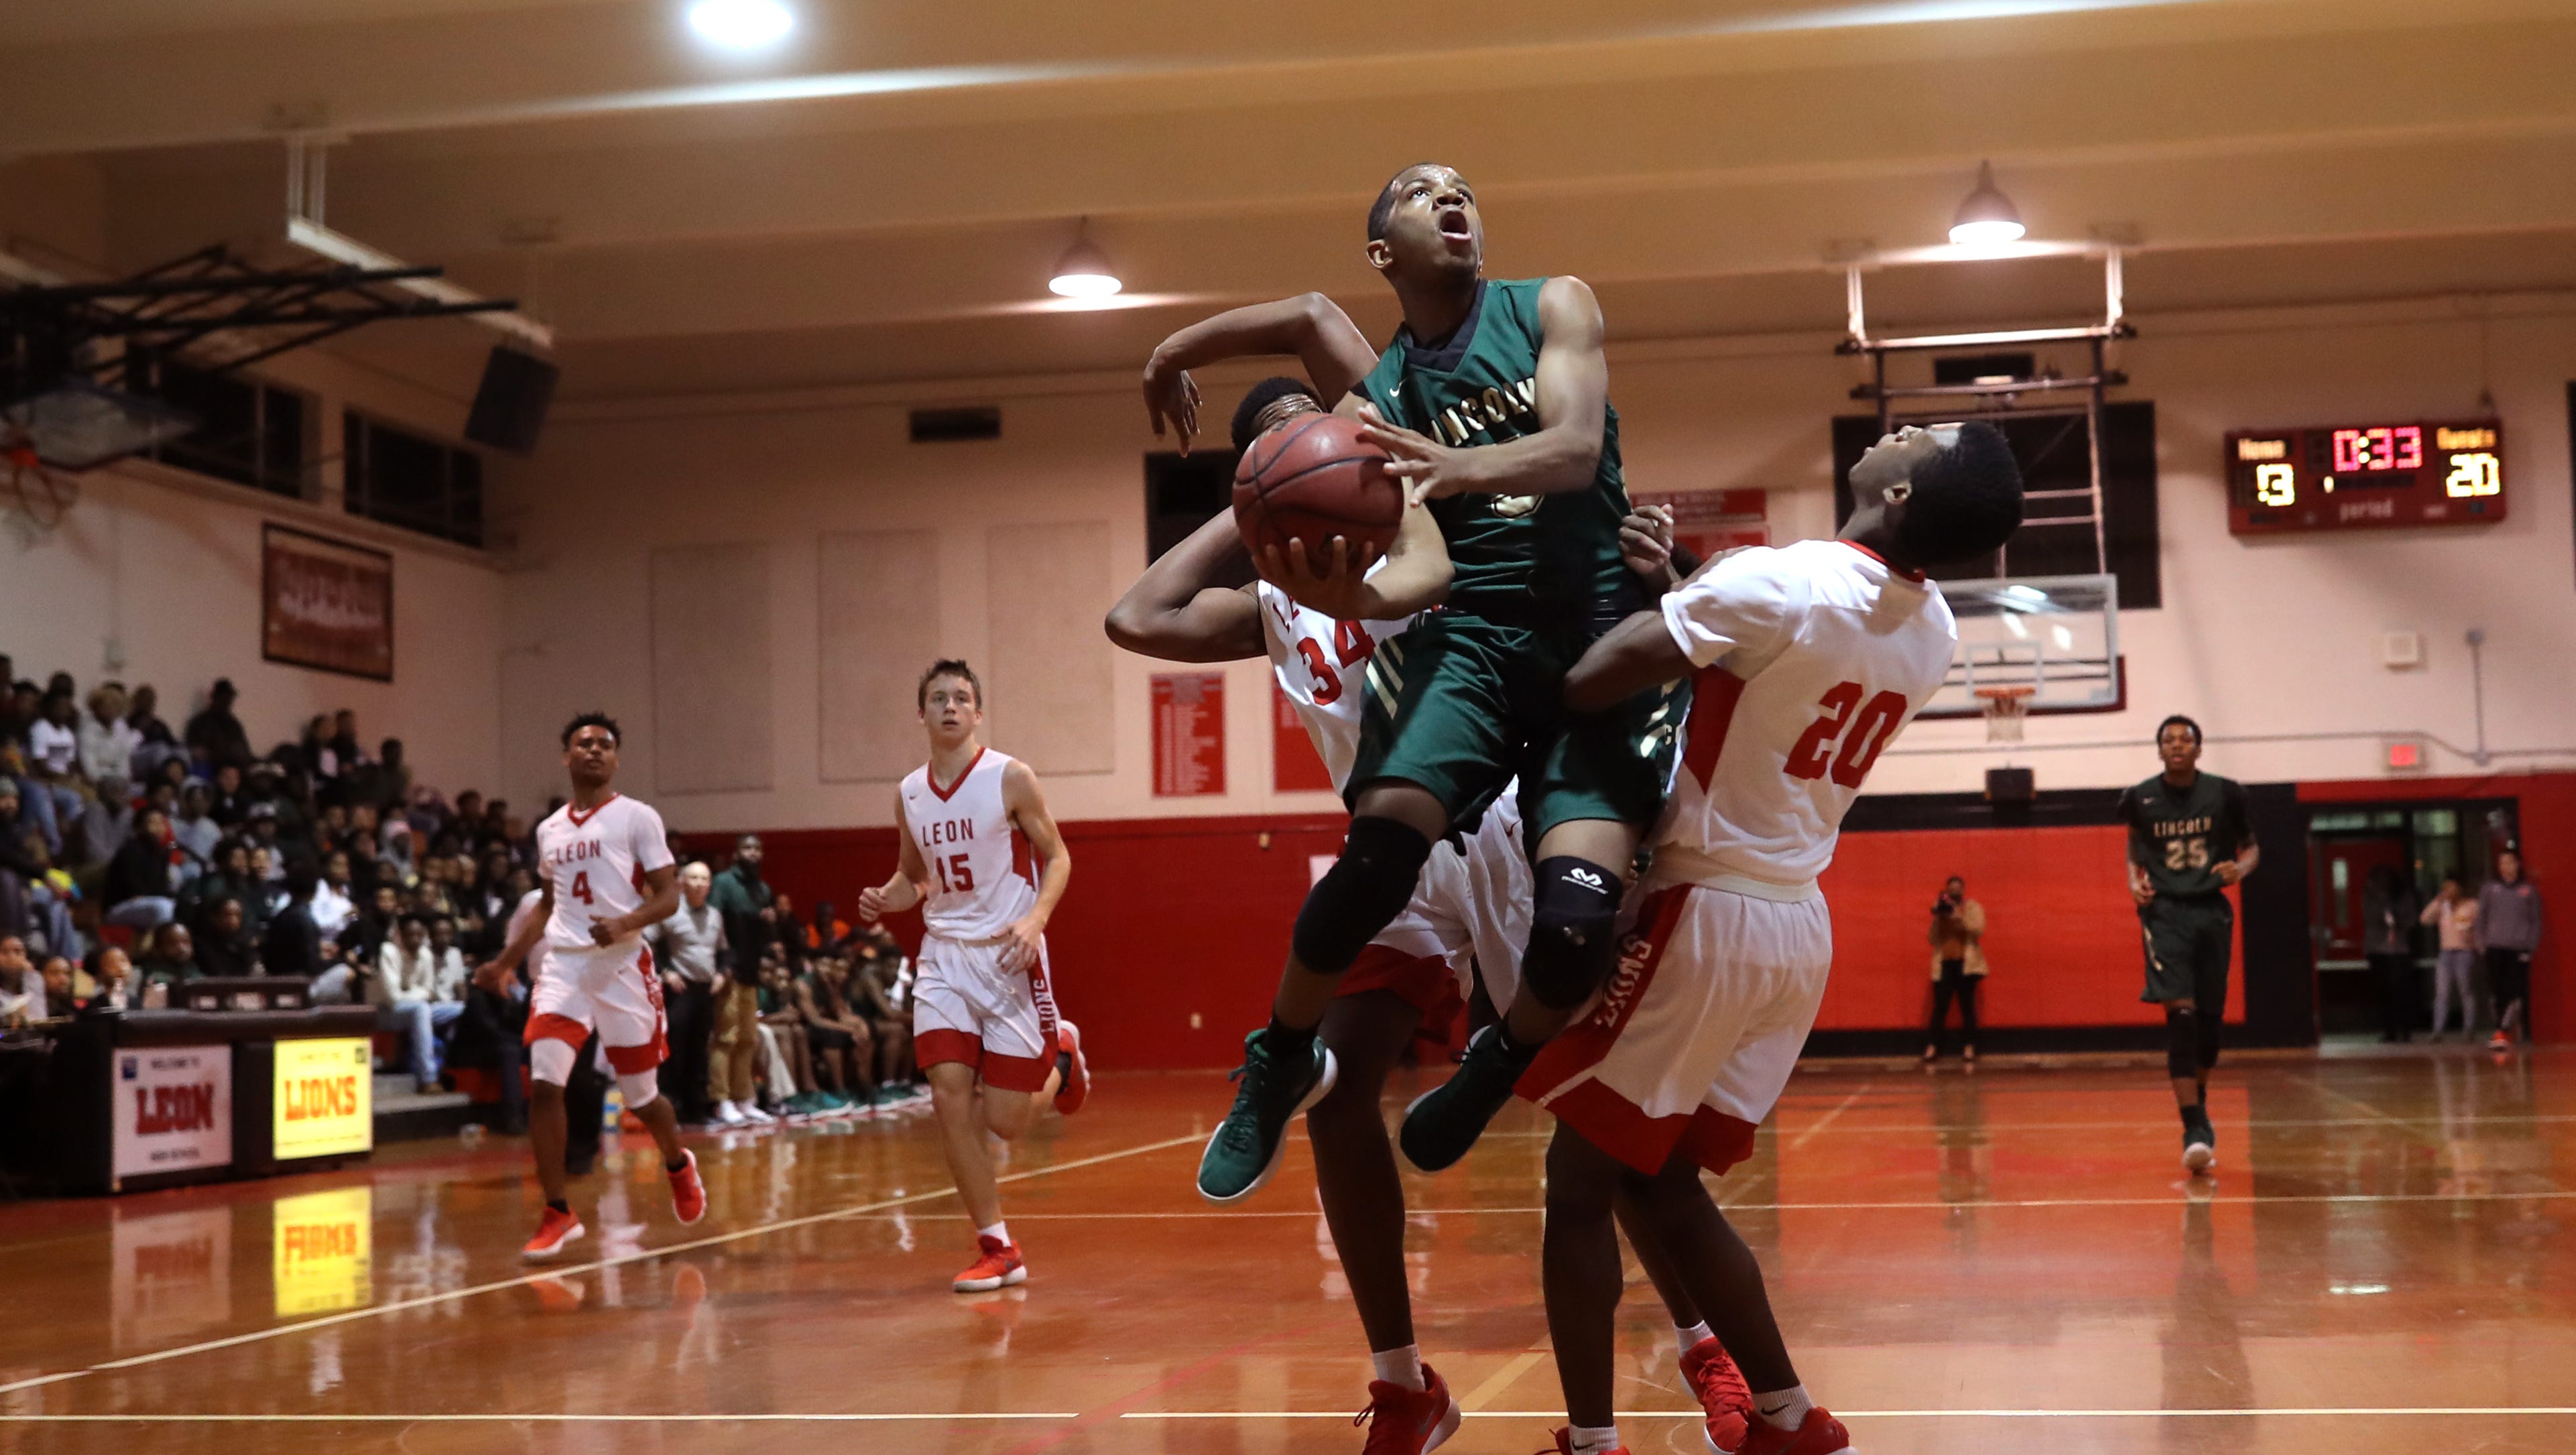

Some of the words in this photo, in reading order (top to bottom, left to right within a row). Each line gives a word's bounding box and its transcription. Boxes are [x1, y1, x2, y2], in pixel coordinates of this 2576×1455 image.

[1430, 377, 1536, 446] INCOLN
[2334, 427, 2422, 471] 0:33
[2446, 453, 2500, 497] 20
[1297, 621, 1375, 706] 34
[1783, 681, 1908, 789] 20
[922, 818, 973, 847] LEON
[2154, 816, 2211, 837] LINCOLN
[556, 839, 601, 865] LEON
[936, 853, 974, 894] 15
[2166, 838, 2209, 870] 25
[572, 870, 593, 905] 4
[136, 1083, 214, 1134] LEON
[285, 1076, 357, 1121] LIONS
